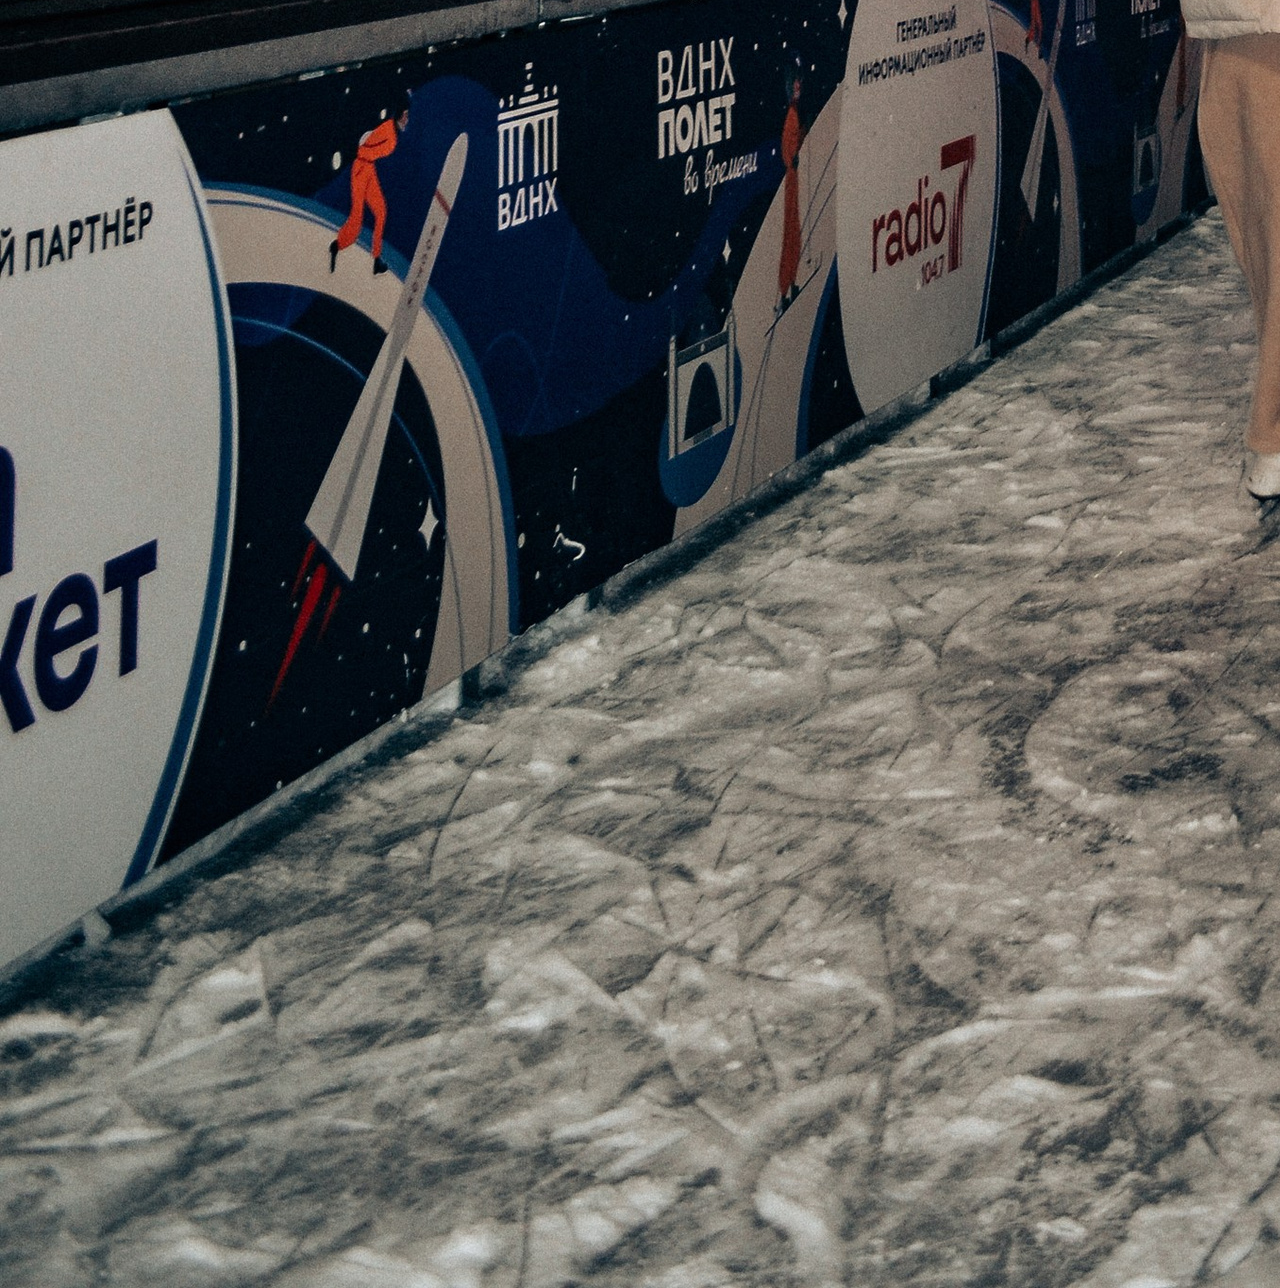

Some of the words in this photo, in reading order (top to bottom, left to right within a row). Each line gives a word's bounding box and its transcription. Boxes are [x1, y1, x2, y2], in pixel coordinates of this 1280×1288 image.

[657, 36, 735, 104] ВДНХ
[657, 92, 736, 160] ПОЛЕТ
[25, 197, 154, 273] ПАРТНЁР
[498, 177, 559, 231] ВДНХ
[872, 174, 947, 274] radio
[940, 134, 977, 274] 7
